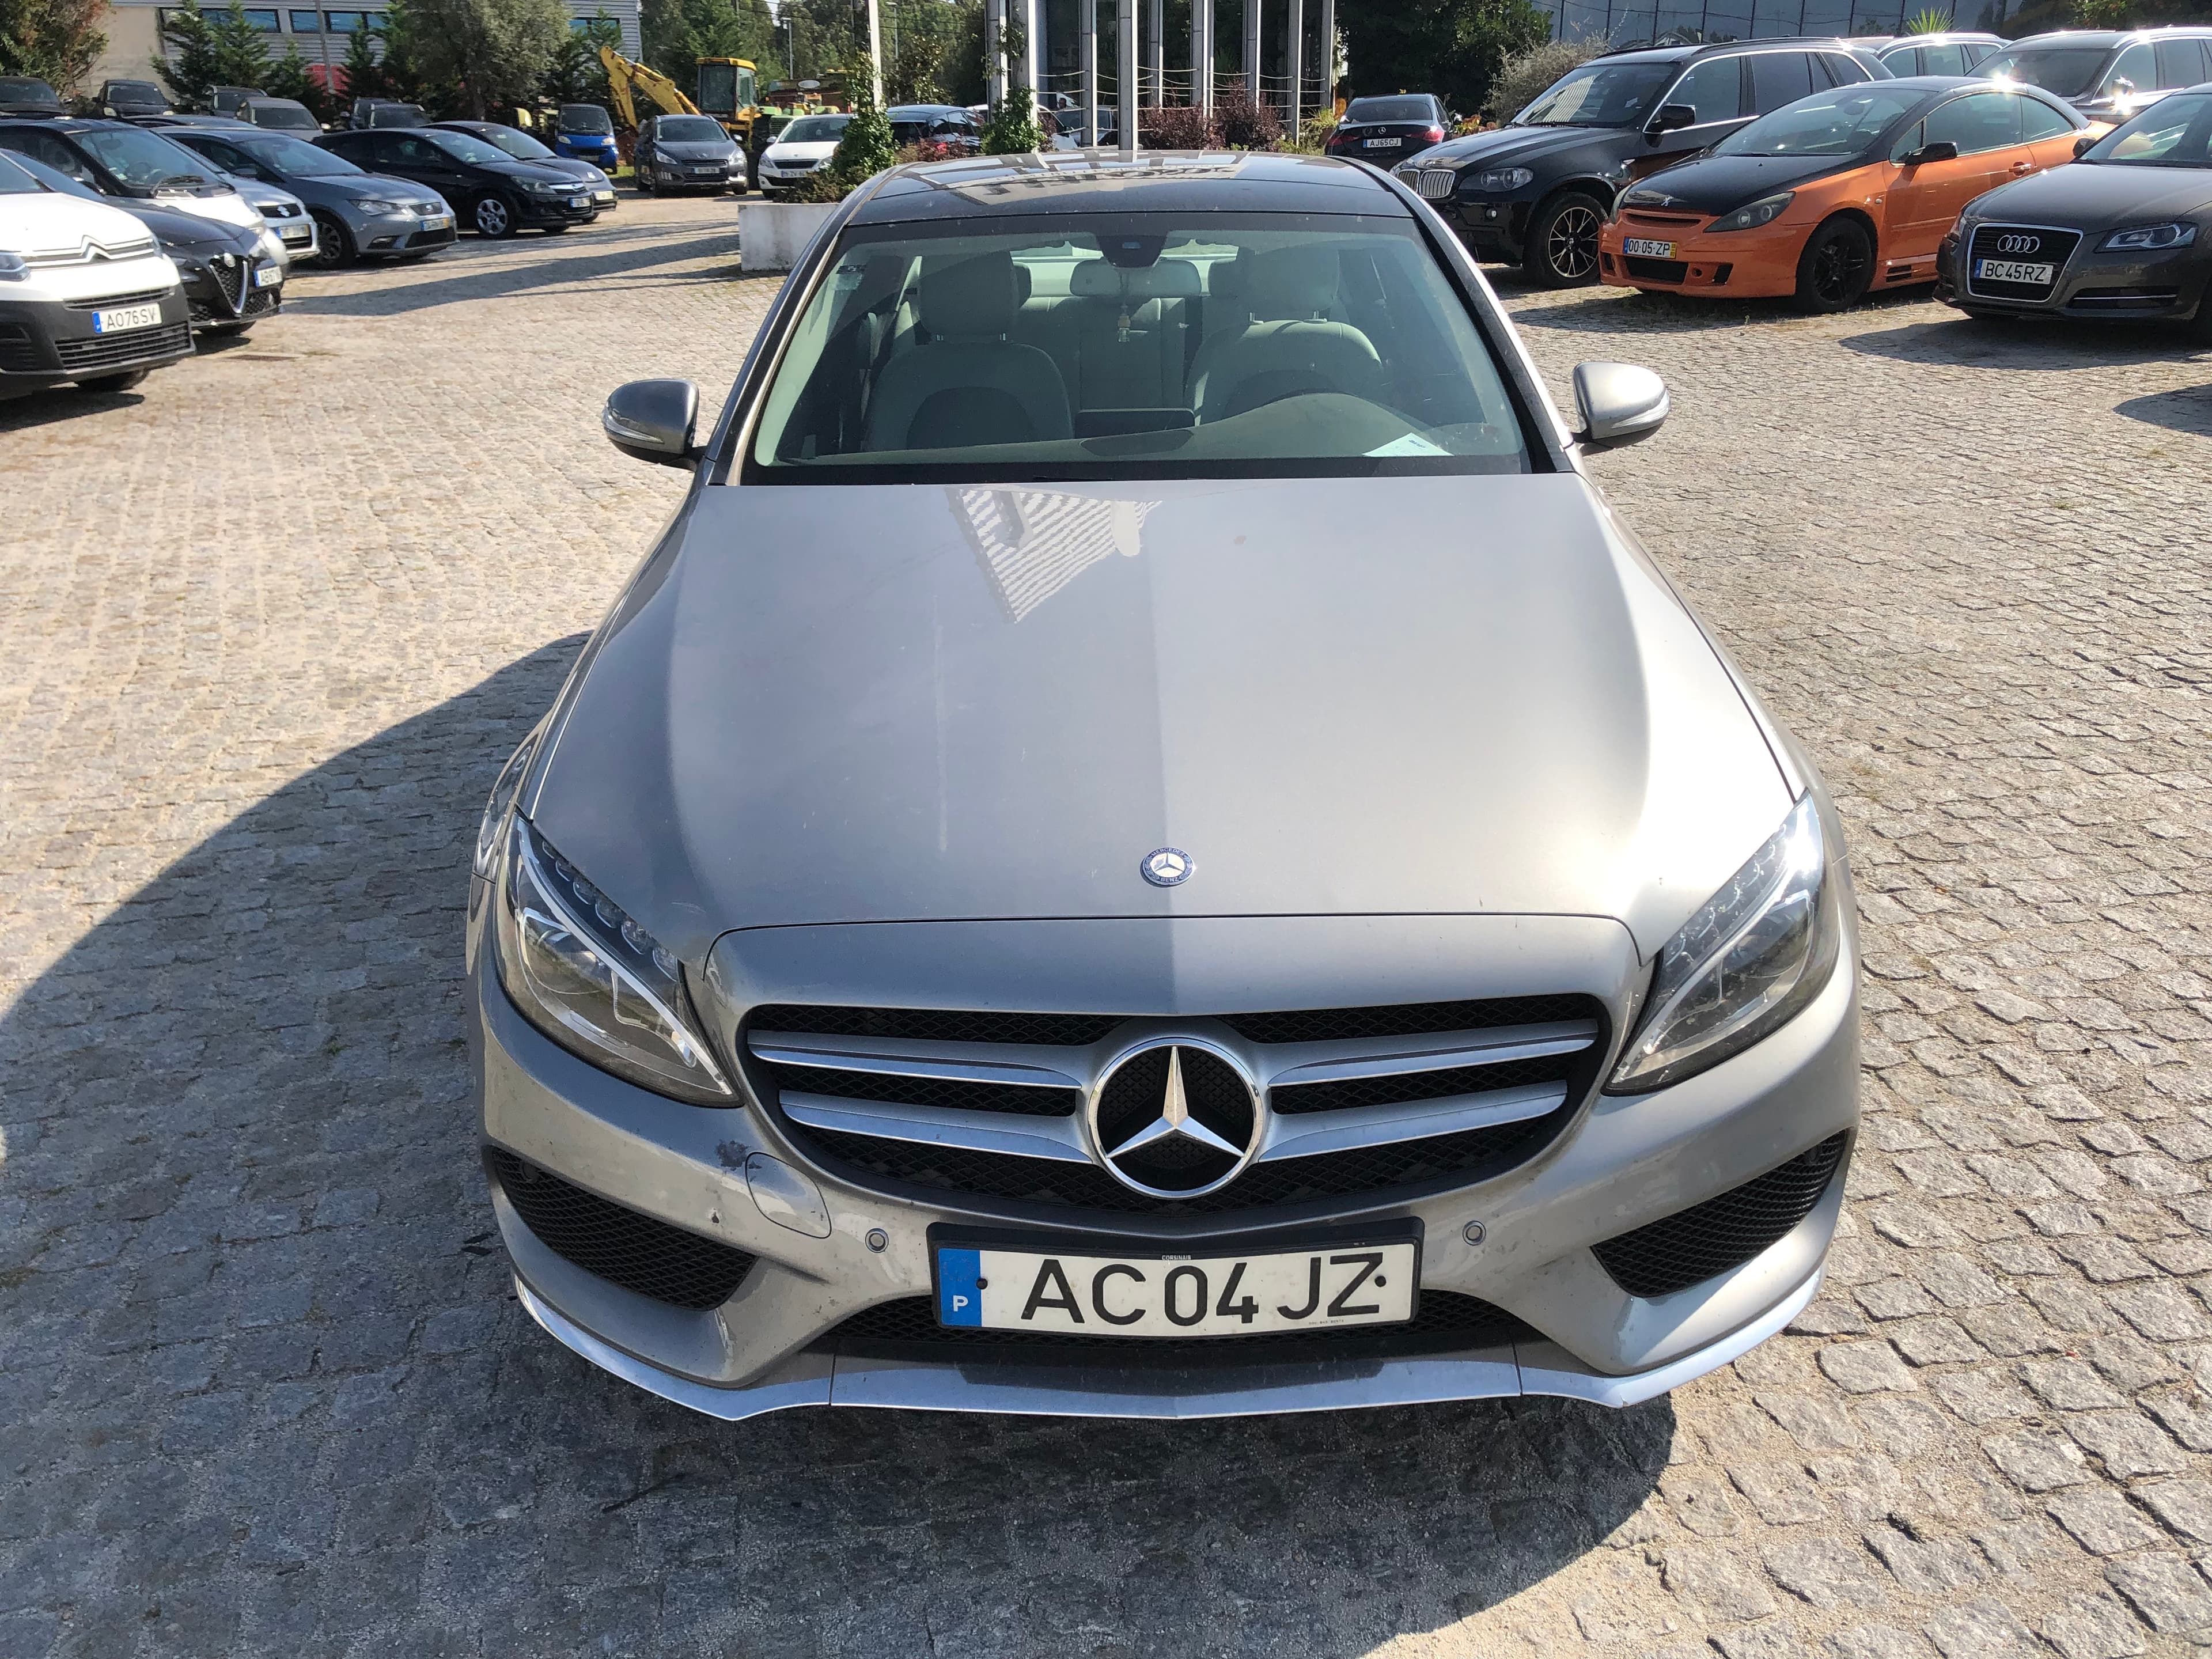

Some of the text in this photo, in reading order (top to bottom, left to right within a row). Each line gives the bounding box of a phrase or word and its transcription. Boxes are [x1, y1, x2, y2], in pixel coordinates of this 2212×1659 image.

[1369, 138, 1399, 147] AJ65CJ
[1984, 262, 2047, 282] BC45RZ
[1151, 847, 1185, 857] MERCEDES
[953, 1295, 968, 1312] P
